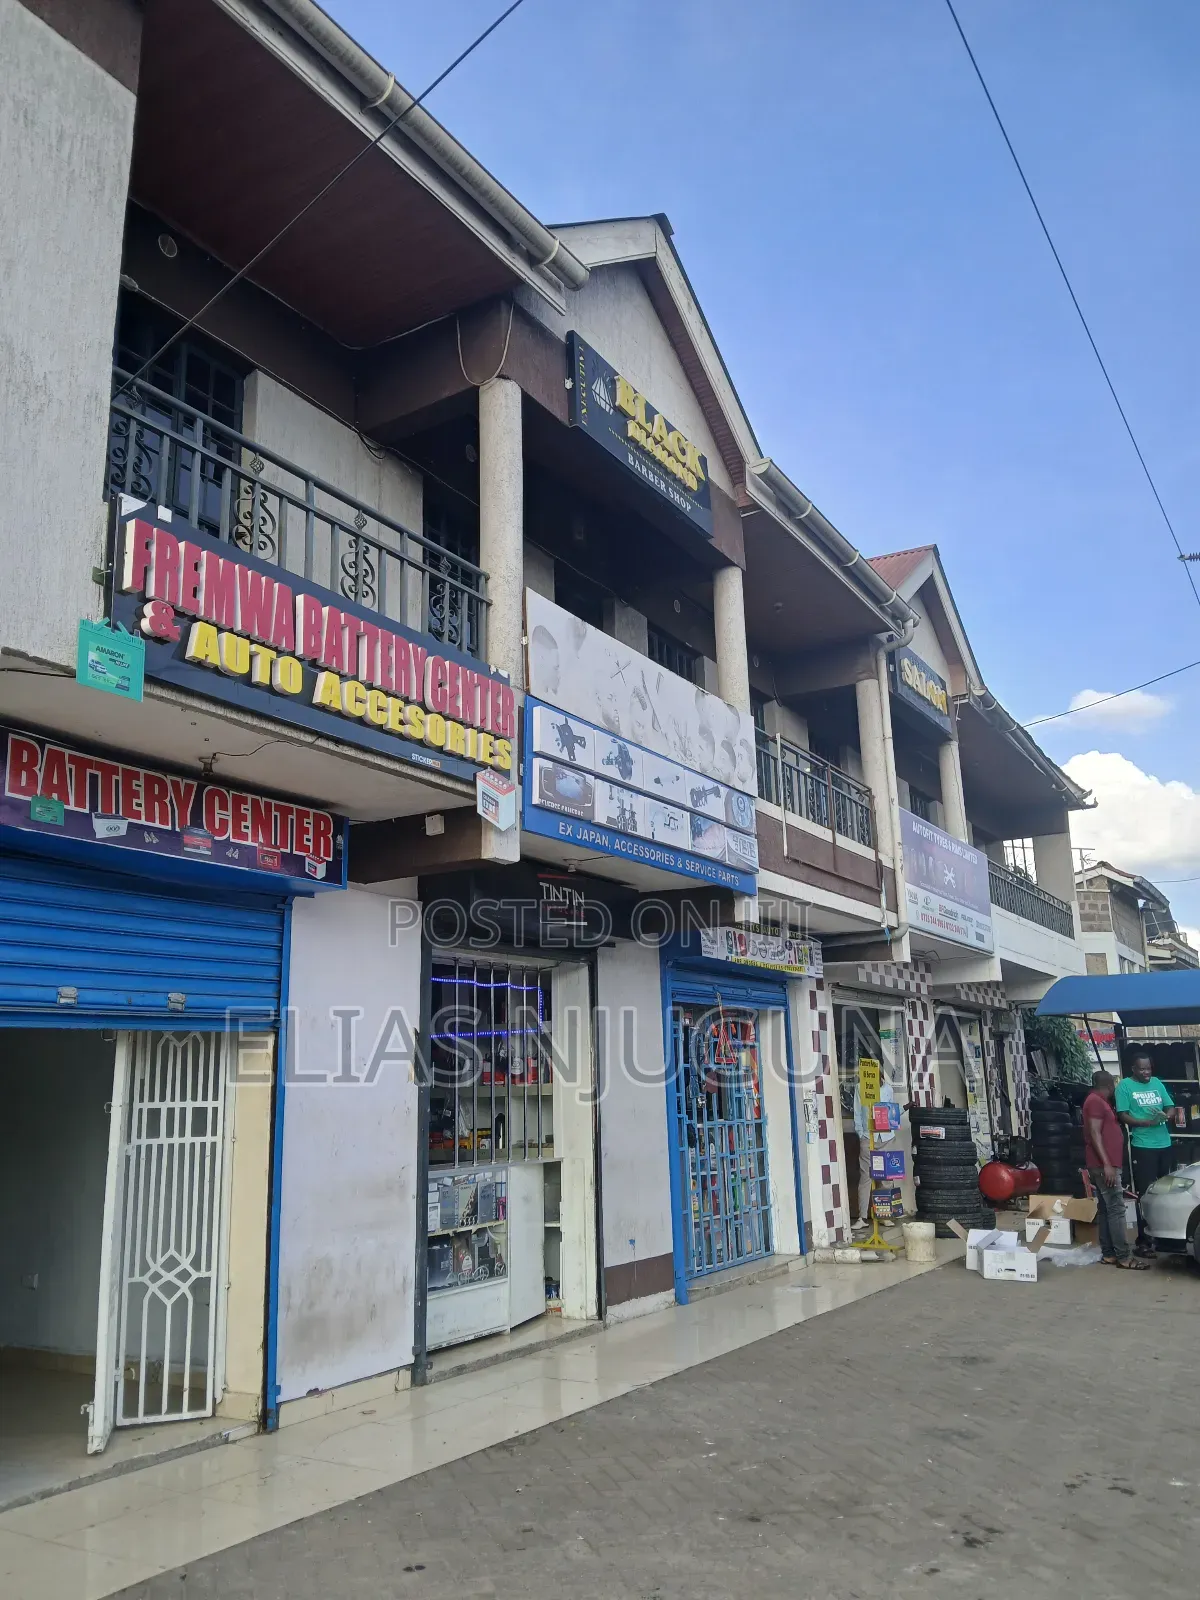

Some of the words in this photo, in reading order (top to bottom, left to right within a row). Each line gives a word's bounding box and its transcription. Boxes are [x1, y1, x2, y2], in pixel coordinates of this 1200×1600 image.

[614, 374, 706, 481] BLACK
[627, 420, 698, 492] DIAMOND
[628, 453, 667, 494] BARBER
[668, 486, 692, 513] SHOP
[95, 645, 124, 660] AMARON
[122, 518, 295, 652] FREMWA
[295, 593, 428, 702] BATTERY
[424, 655, 514, 738] CENTER
[140, 600, 181, 642] &
[186, 621, 303, 695] AUTO
[313, 670, 512, 770] ACCESORIES
[5, 733, 198, 832] BATTERY
[203, 785, 333, 861] CENTER
[558, 821, 573, 836] EX
[577, 827, 612, 850] JAPAN,
[614, 838, 675, 867] ACCESSORIES
[677, 857, 683, 869] &
[685, 859, 717, 880] SERVICE
[718, 870, 740, 887] PARTS
[912, 821, 933, 840] AUTOFIT
[539, 882, 585, 907] TINTIN
[1139, 1096, 1161, 1104] LIGHT
